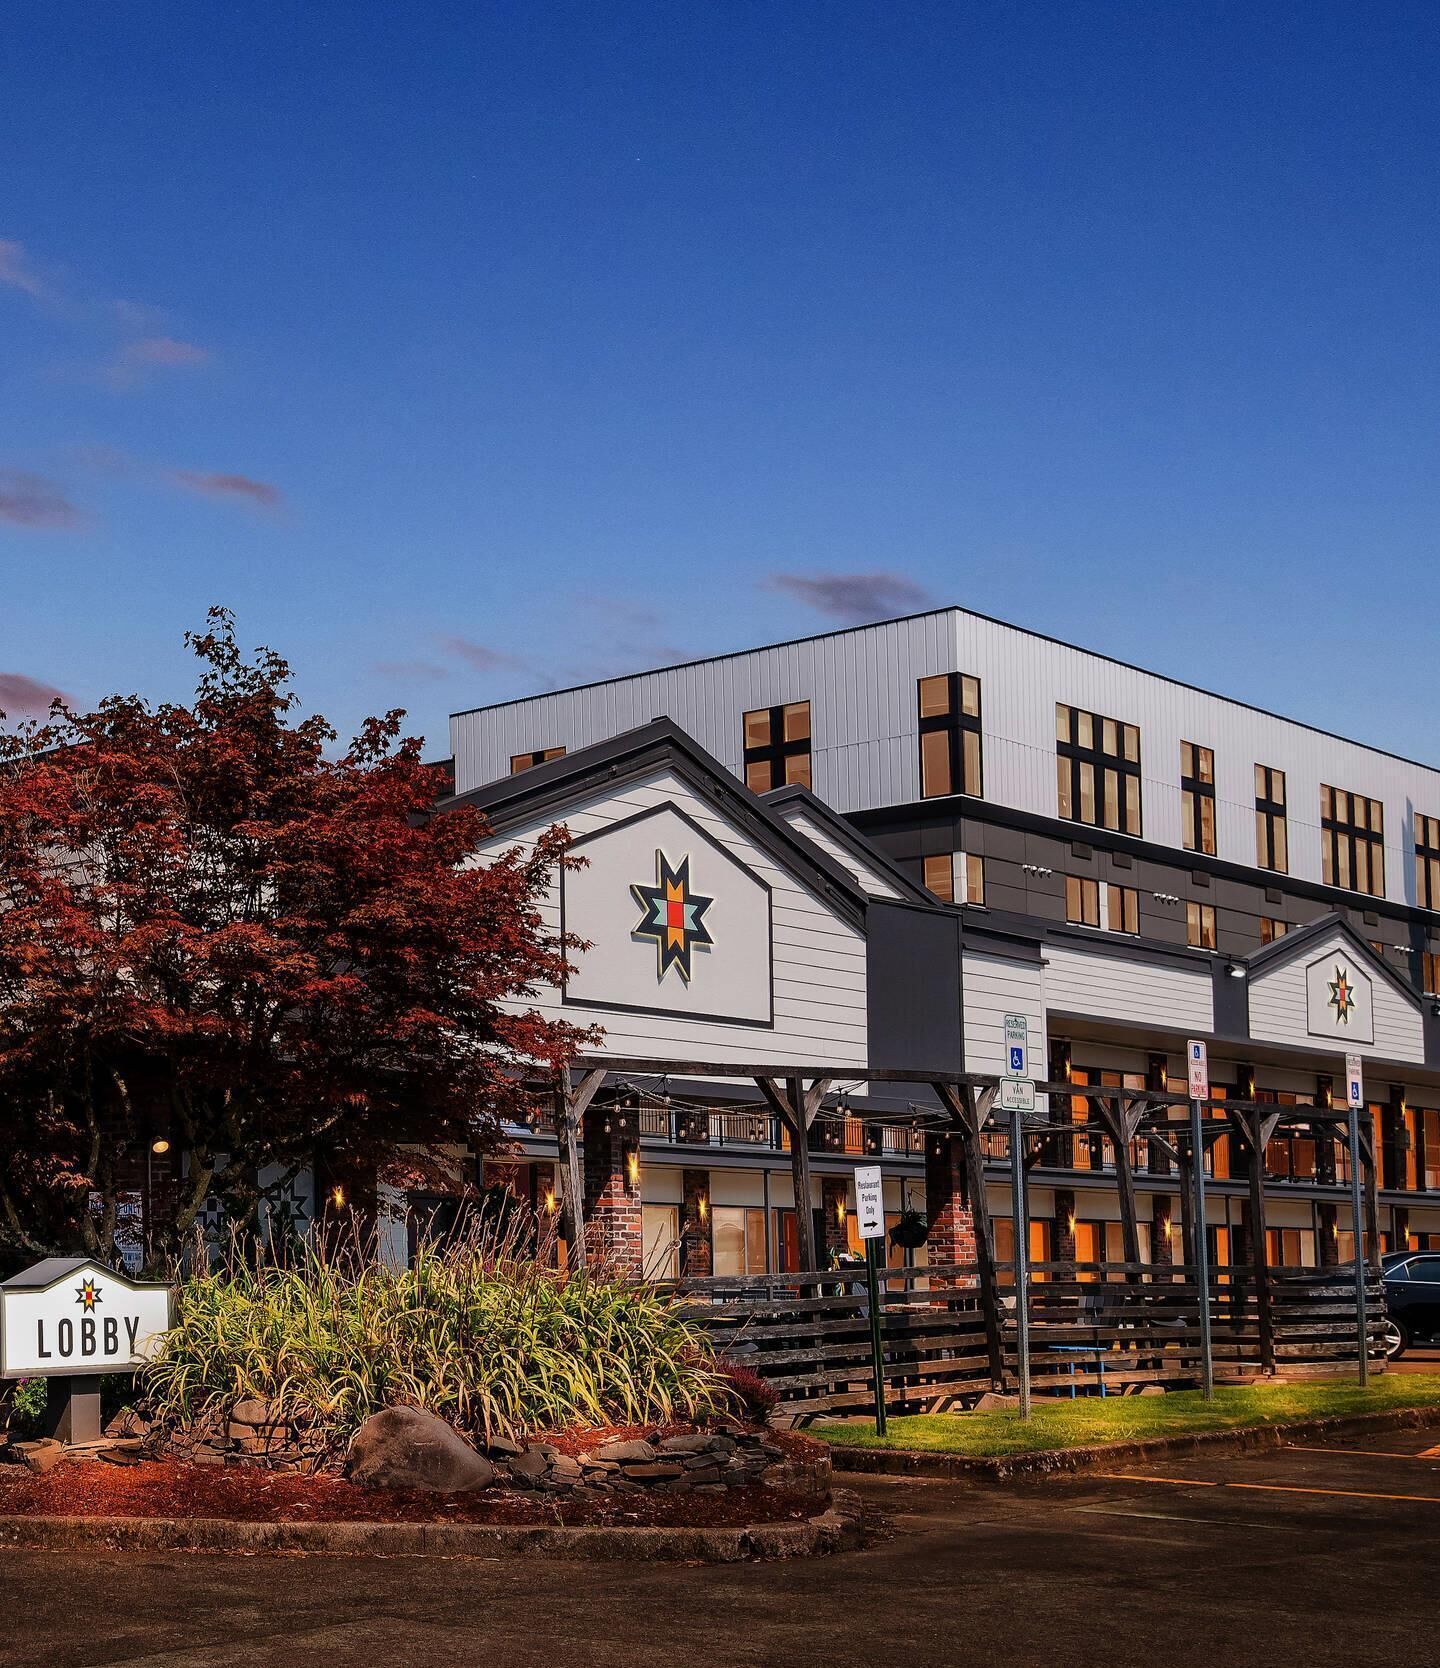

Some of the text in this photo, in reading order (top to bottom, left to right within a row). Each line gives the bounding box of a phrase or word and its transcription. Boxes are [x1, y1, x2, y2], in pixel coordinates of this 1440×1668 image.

[1007, 1030, 1025, 1041] PARKING
[1194, 1071, 1202, 1082] NO
[1012, 1086, 1024, 1095] VAN
[857, 1180, 880, 1190] Restaurant
[861, 1193, 878, 1203] Parking
[865, 1206, 875, 1216] Only
[37, 1316, 140, 1358] LOBBY
